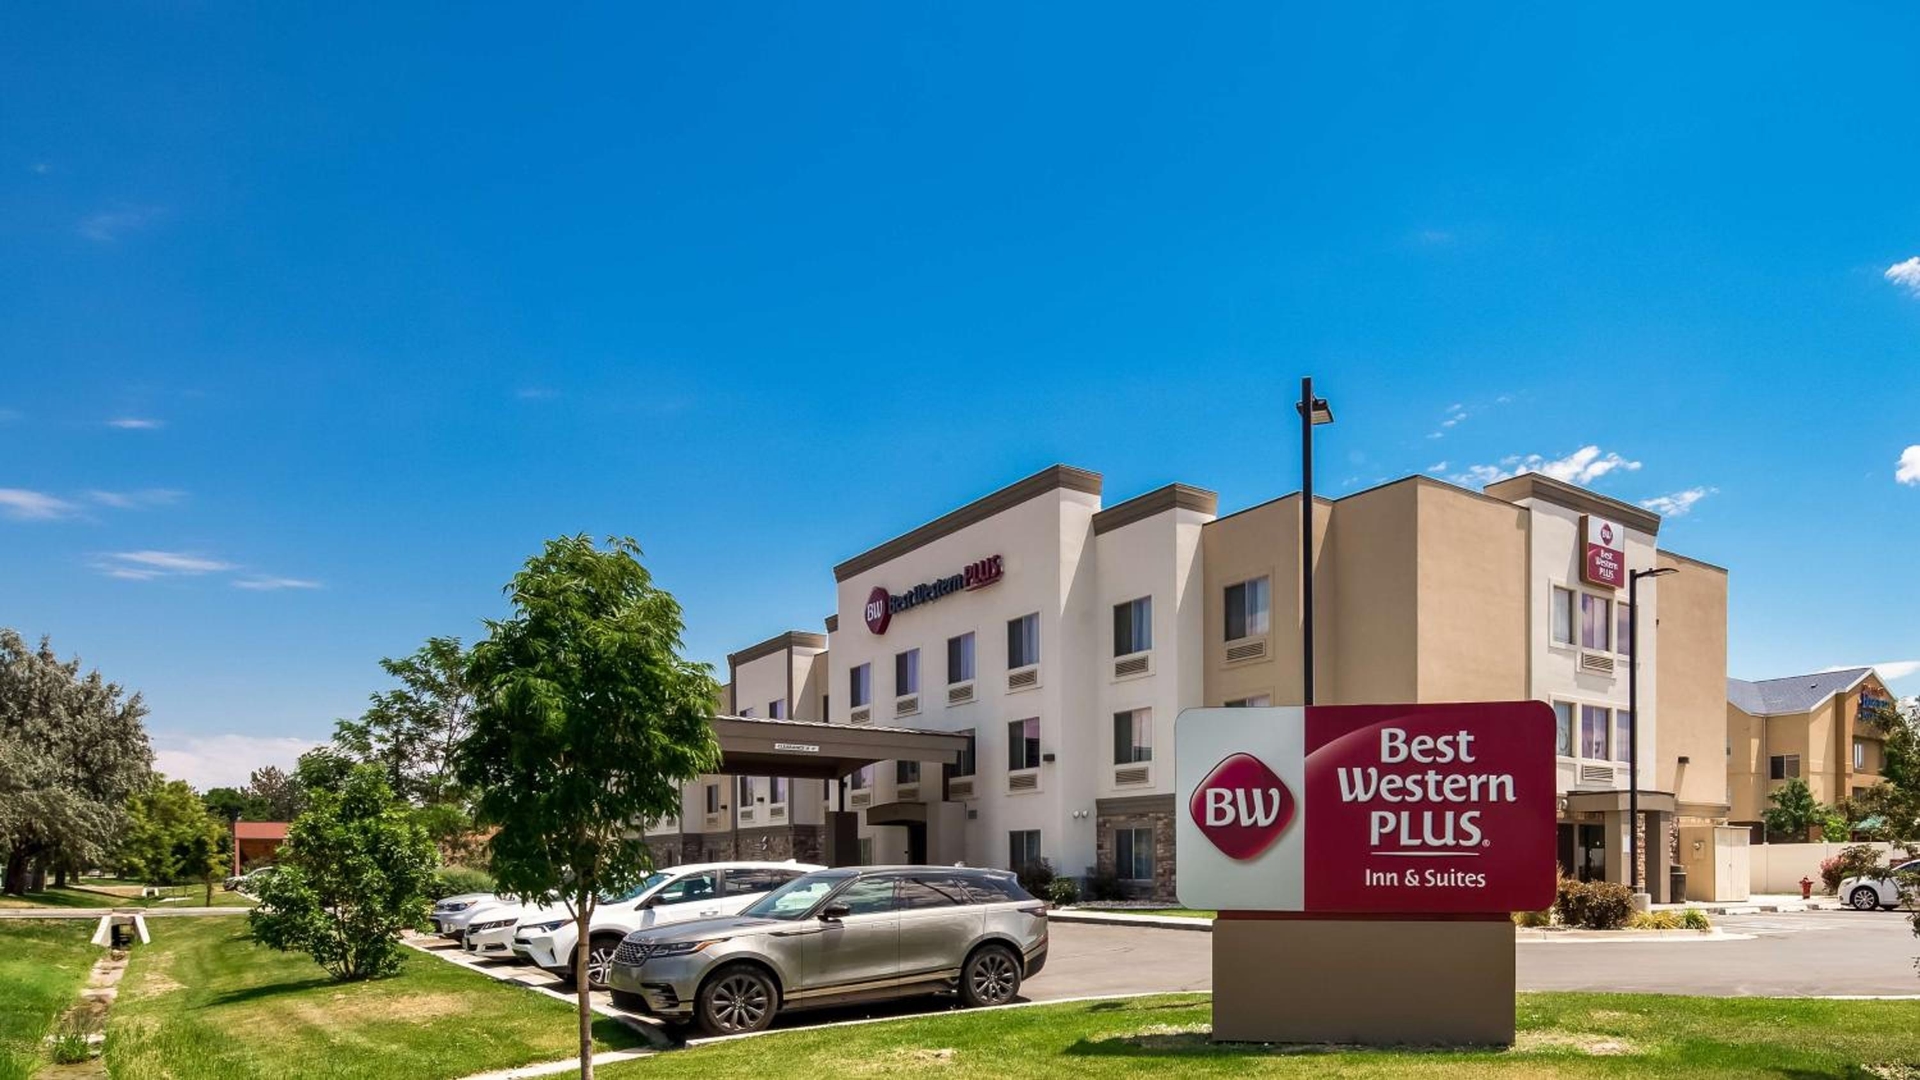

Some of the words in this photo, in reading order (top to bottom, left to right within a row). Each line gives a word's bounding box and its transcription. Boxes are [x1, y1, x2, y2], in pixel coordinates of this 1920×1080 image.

[1595, 556, 1618, 570] Western
[1601, 547, 1613, 560] Best
[889, 590, 914, 614] Best
[913, 574, 964, 603] Western
[964, 554, 1004, 587] PLUS
[1600, 567, 1614, 578] PLUS
[867, 599, 883, 621] BW
[1380, 727, 1476, 764] Best
[1337, 766, 1517, 803] Western
[1204, 787, 1281, 828] BW
[1370, 810, 1483, 848] PLUS
[1365, 868, 1399, 887] Inn
[1405, 869, 1420, 887] &
[1424, 868, 1487, 888] Suites
